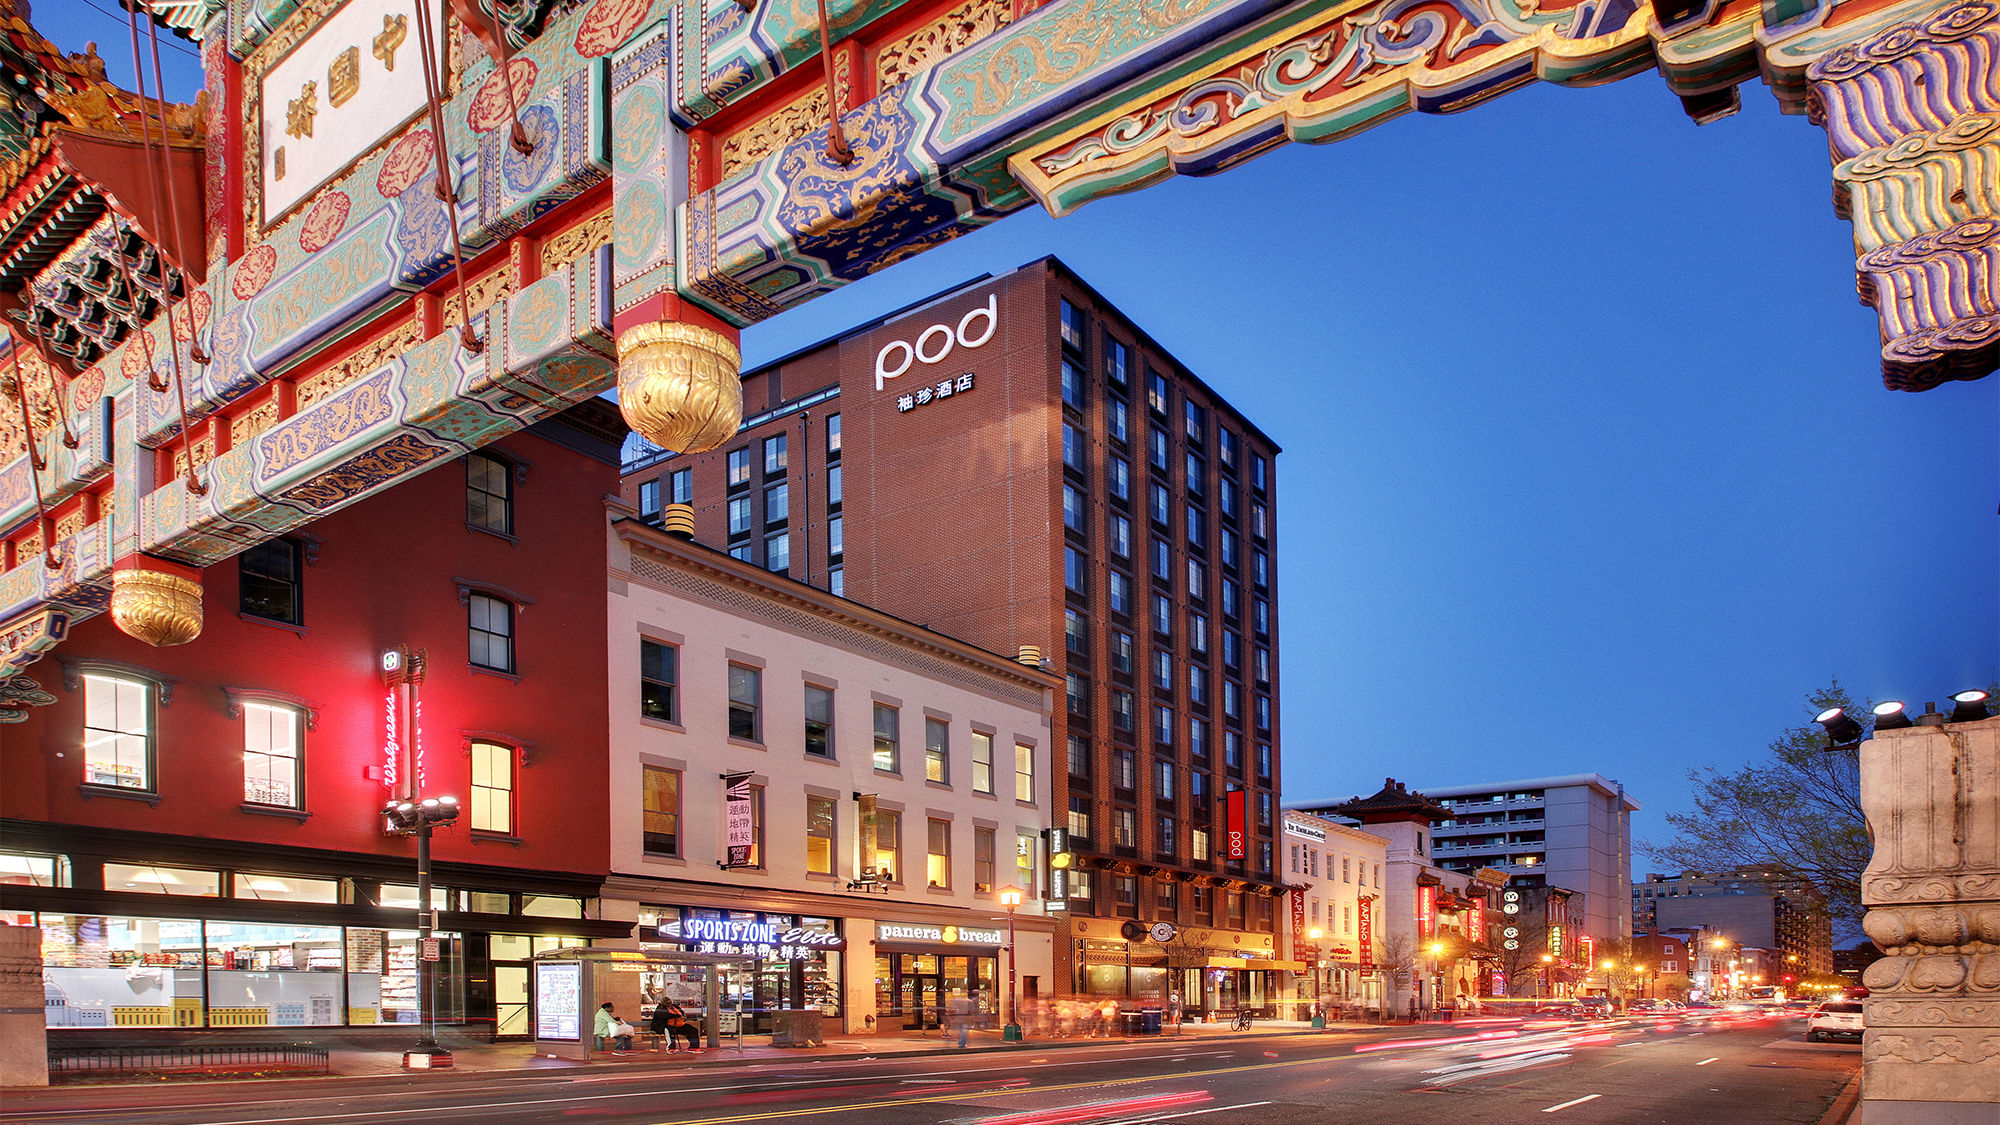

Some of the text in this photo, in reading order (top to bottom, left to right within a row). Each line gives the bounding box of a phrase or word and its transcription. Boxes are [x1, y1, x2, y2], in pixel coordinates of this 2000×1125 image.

[876, 293, 998, 391] pod
[897, 373, 974, 412] 袖珍酒店
[384, 691, 400, 786] Walgreens
[1053, 830, 1061, 853] bread
[1229, 831, 1243, 856] pod
[1053, 870, 1062, 898] panera
[1293, 892, 1303, 936] VAPIANO
[1360, 901, 1370, 941] VAPIANO
[686, 919, 842, 945] SPORTS ZONE Elite
[880, 925, 1002, 943] panera bread
[700, 941, 810, 960] 運動 地帶 精英
